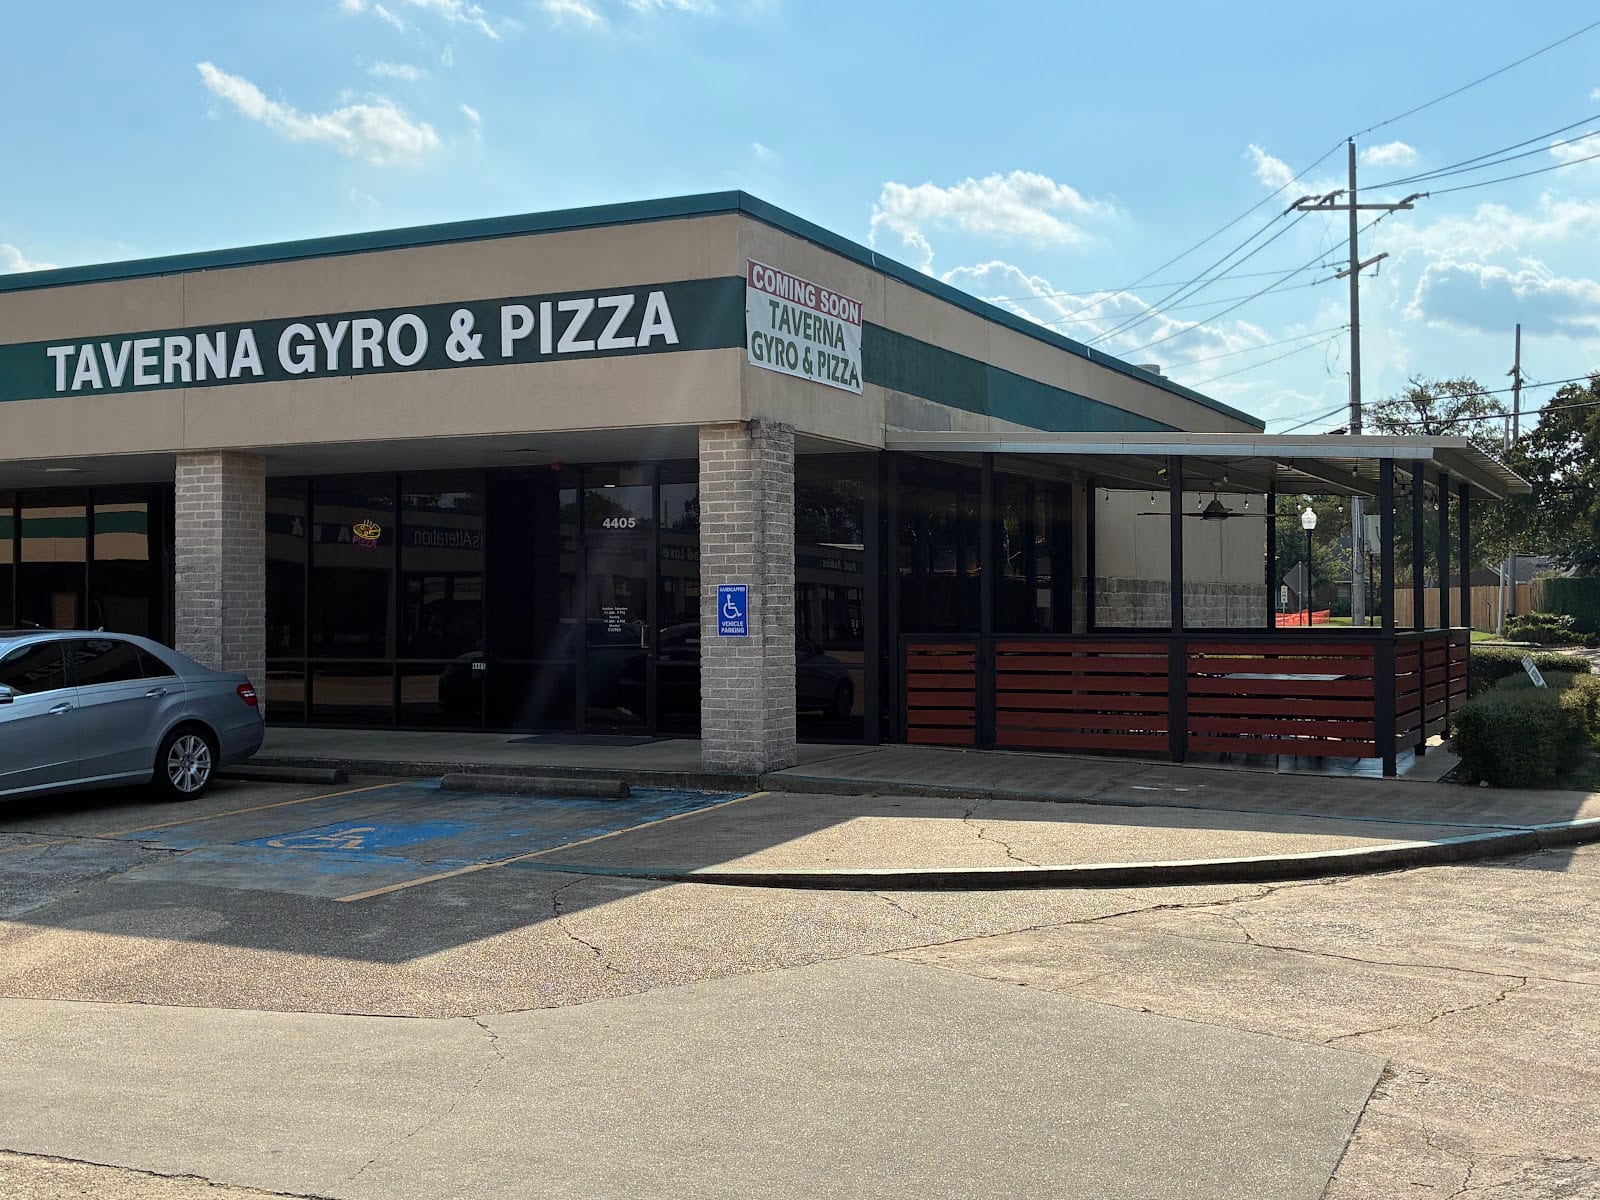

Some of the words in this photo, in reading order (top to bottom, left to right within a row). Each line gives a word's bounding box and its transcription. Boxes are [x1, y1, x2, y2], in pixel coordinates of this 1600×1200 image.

[752, 265, 816, 308] COMING
[820, 290, 859, 324] SOON
[47, 328, 264, 392] TAVERNA
[277, 313, 429, 375] GYRO
[445, 308, 485, 362] &
[500, 291, 680, 357] PIZZA
[768, 299, 846, 352] TAVERNA
[751, 330, 799, 371] GYRO
[802, 346, 814, 375] &
[817, 350, 861, 389] PIZZA
[602, 517, 636, 529] 4405
